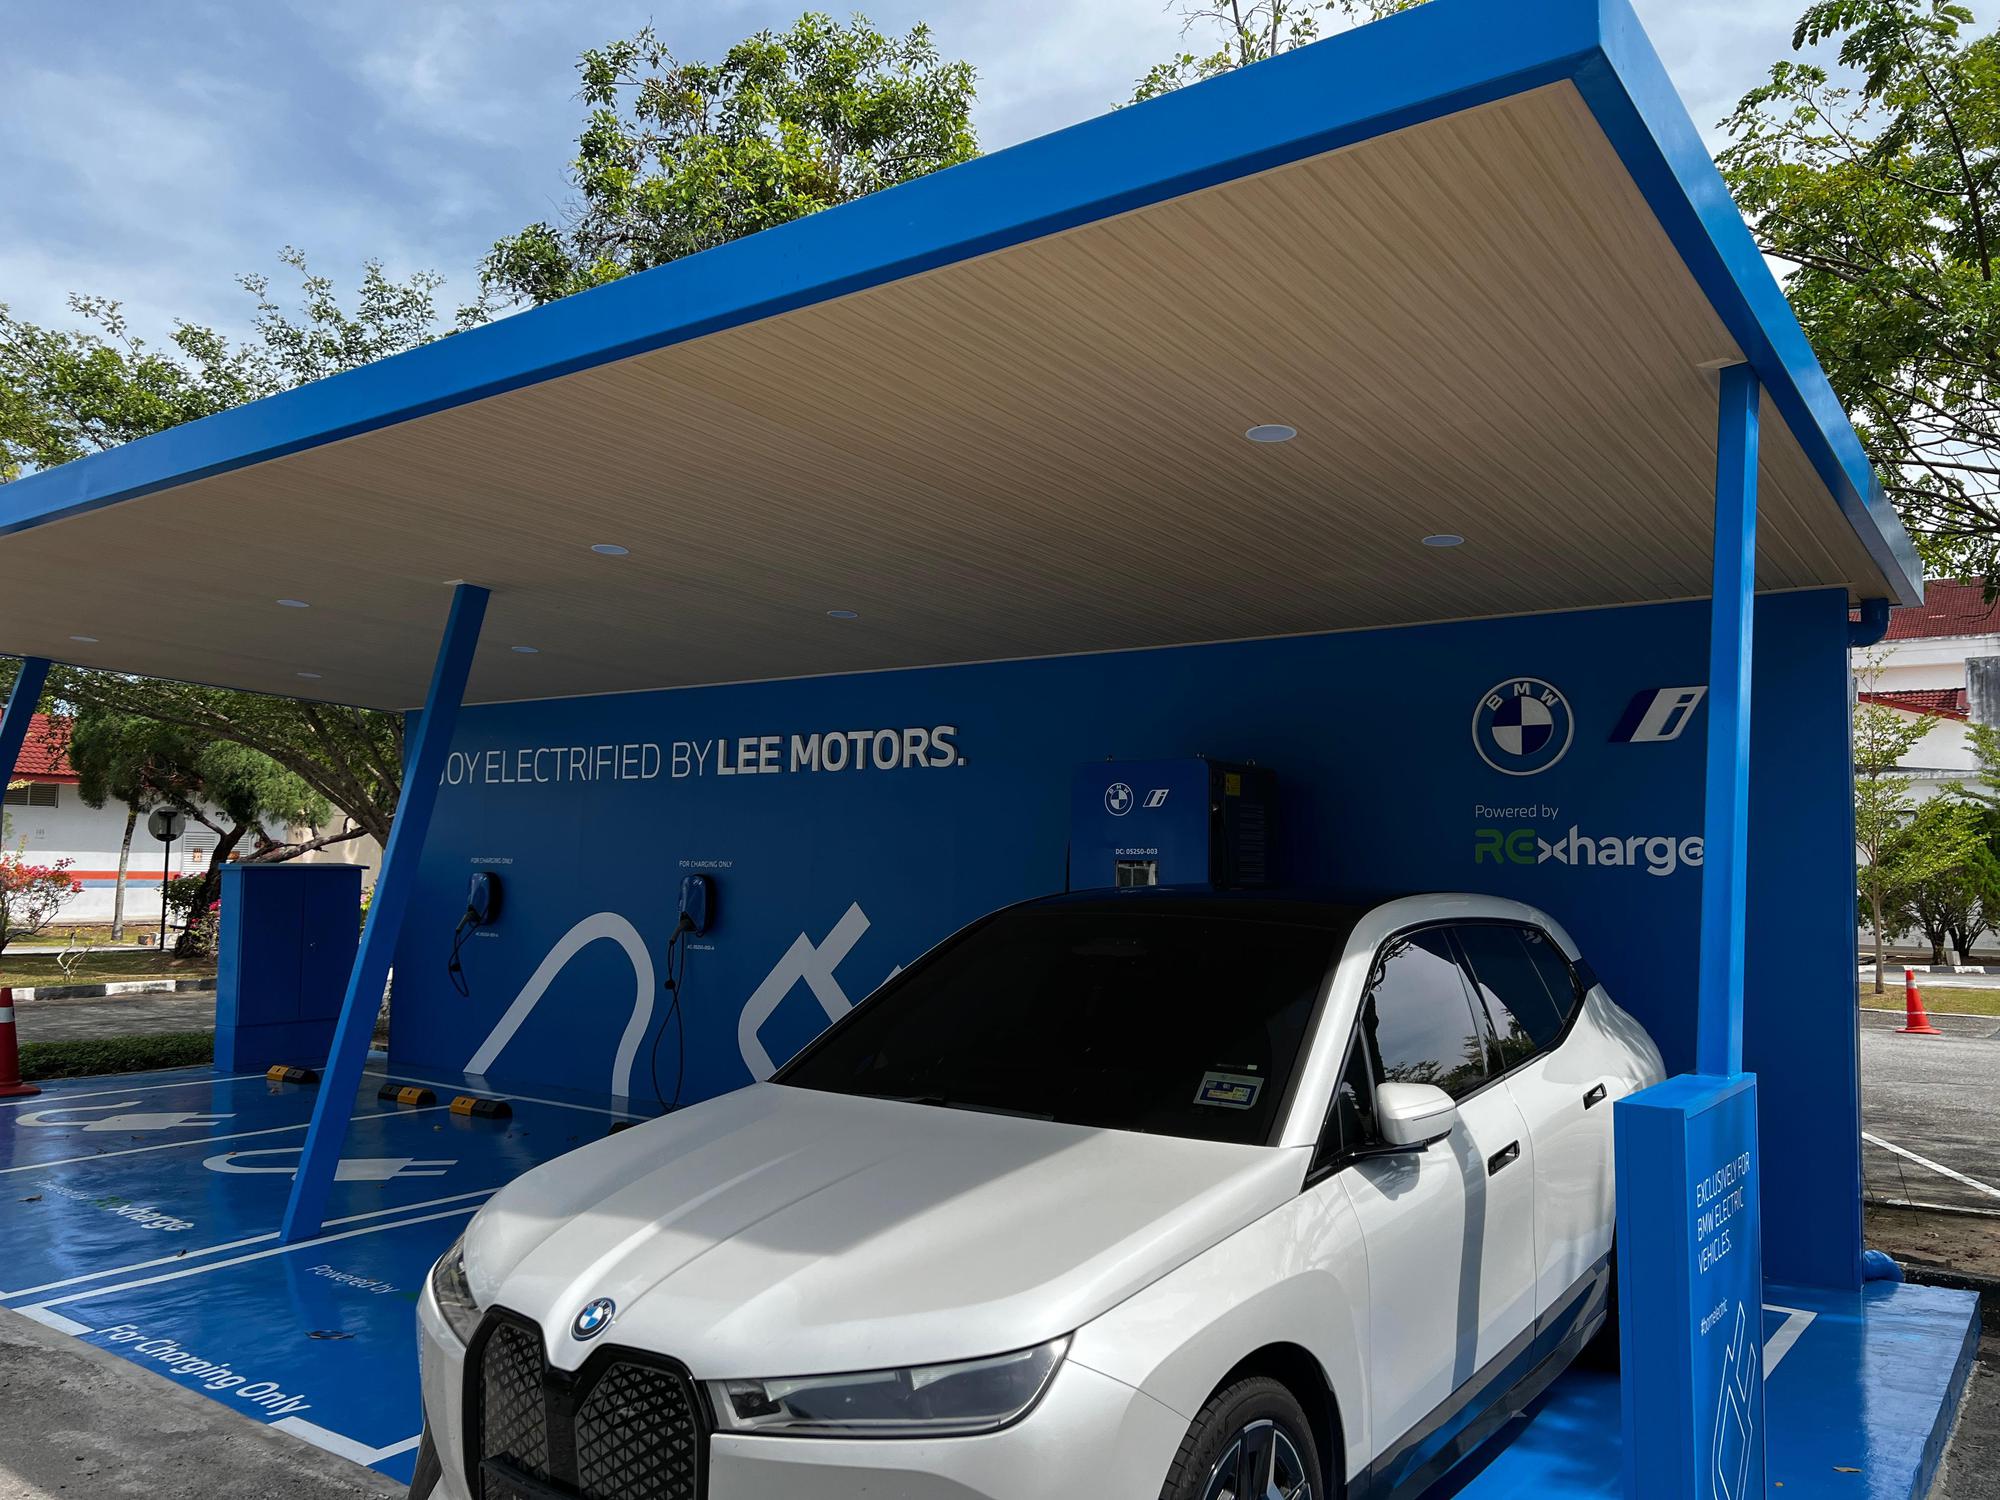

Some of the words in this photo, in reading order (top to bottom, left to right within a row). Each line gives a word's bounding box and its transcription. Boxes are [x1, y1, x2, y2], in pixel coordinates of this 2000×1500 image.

[485, 743, 661, 783] ELECTRIFIED
[671, 739, 713, 778] BY
[717, 736, 783, 775] LEE
[790, 725, 967, 773] MOTORS.
[1475, 804, 1537, 818] Powered
[1541, 804, 1559, 820] by
[679, 860, 690, 868] FOR
[691, 860, 717, 868] CHARGING
[718, 860, 733, 868] ONLY
[1697, 1157, 1739, 1208] EXCLUSIVELY
[1737, 1151, 1751, 1180] FOR
[1697, 1209, 1714, 1242] BMW
[1715, 1186, 1744, 1228] ELECTRIC
[1698, 1229, 1732, 1275] VEHICLES.
[305, 1264, 377, 1288] Powered
[370, 1281, 401, 1295] by
[96, 1323, 148, 1343] For
[134, 1338, 247, 1390] Charging
[235, 1381, 312, 1416] Only
